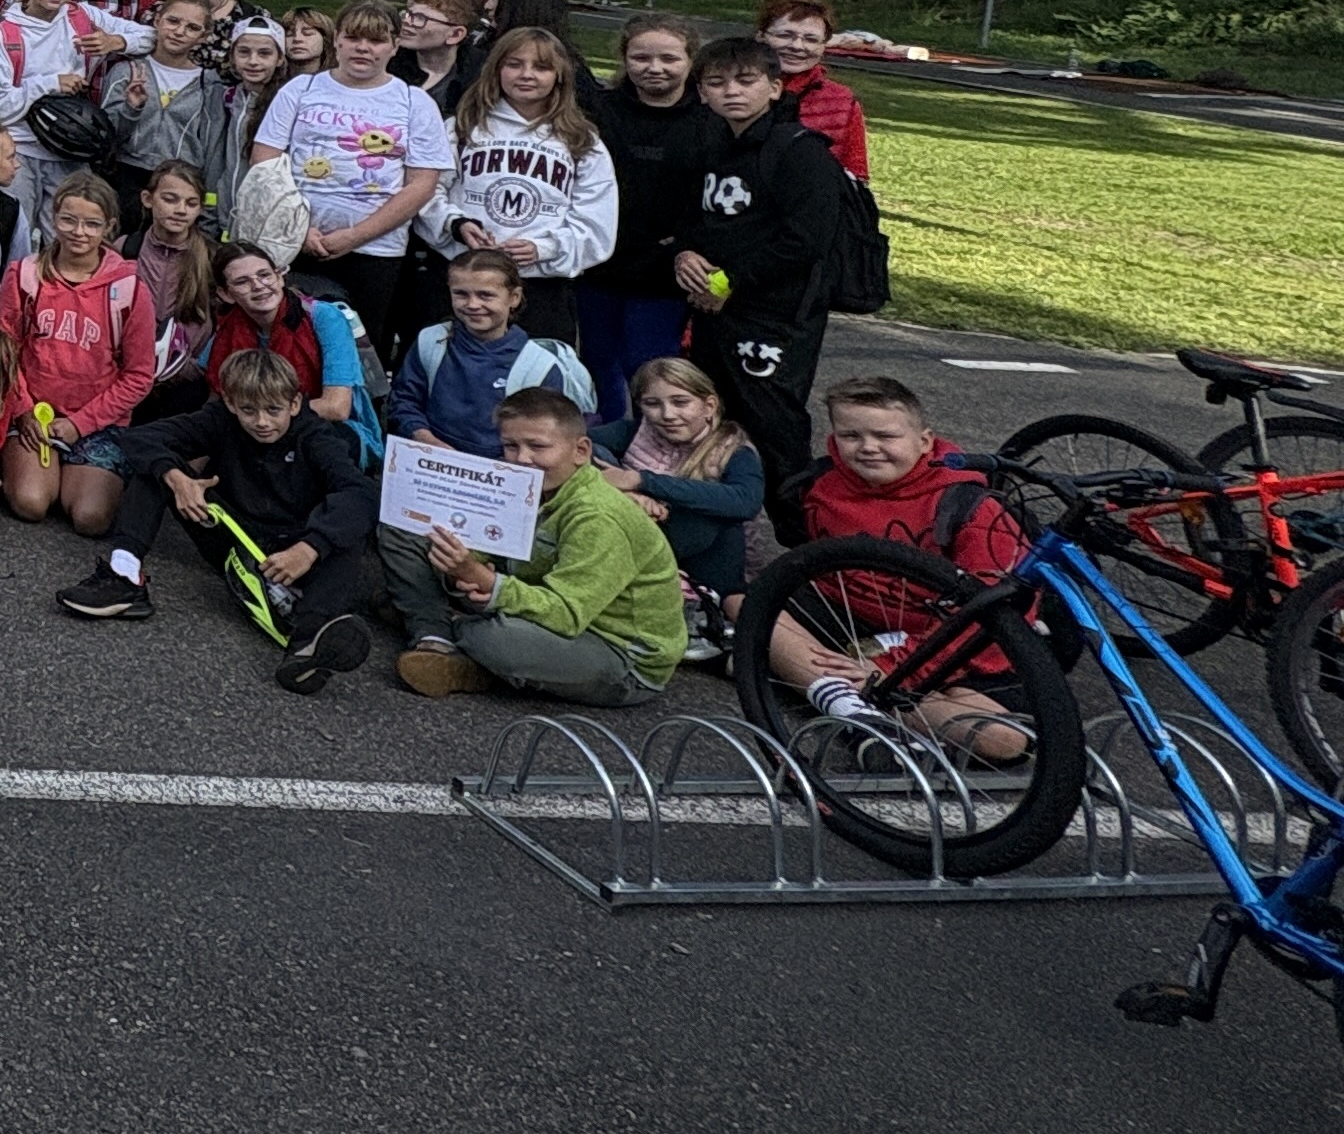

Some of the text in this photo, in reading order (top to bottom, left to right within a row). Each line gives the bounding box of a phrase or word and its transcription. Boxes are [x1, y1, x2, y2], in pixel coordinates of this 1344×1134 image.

[501, 189, 525, 217] M
[36, 308, 101, 351] GAP
[417, 457, 506, 488] CERTIFIKÁT
